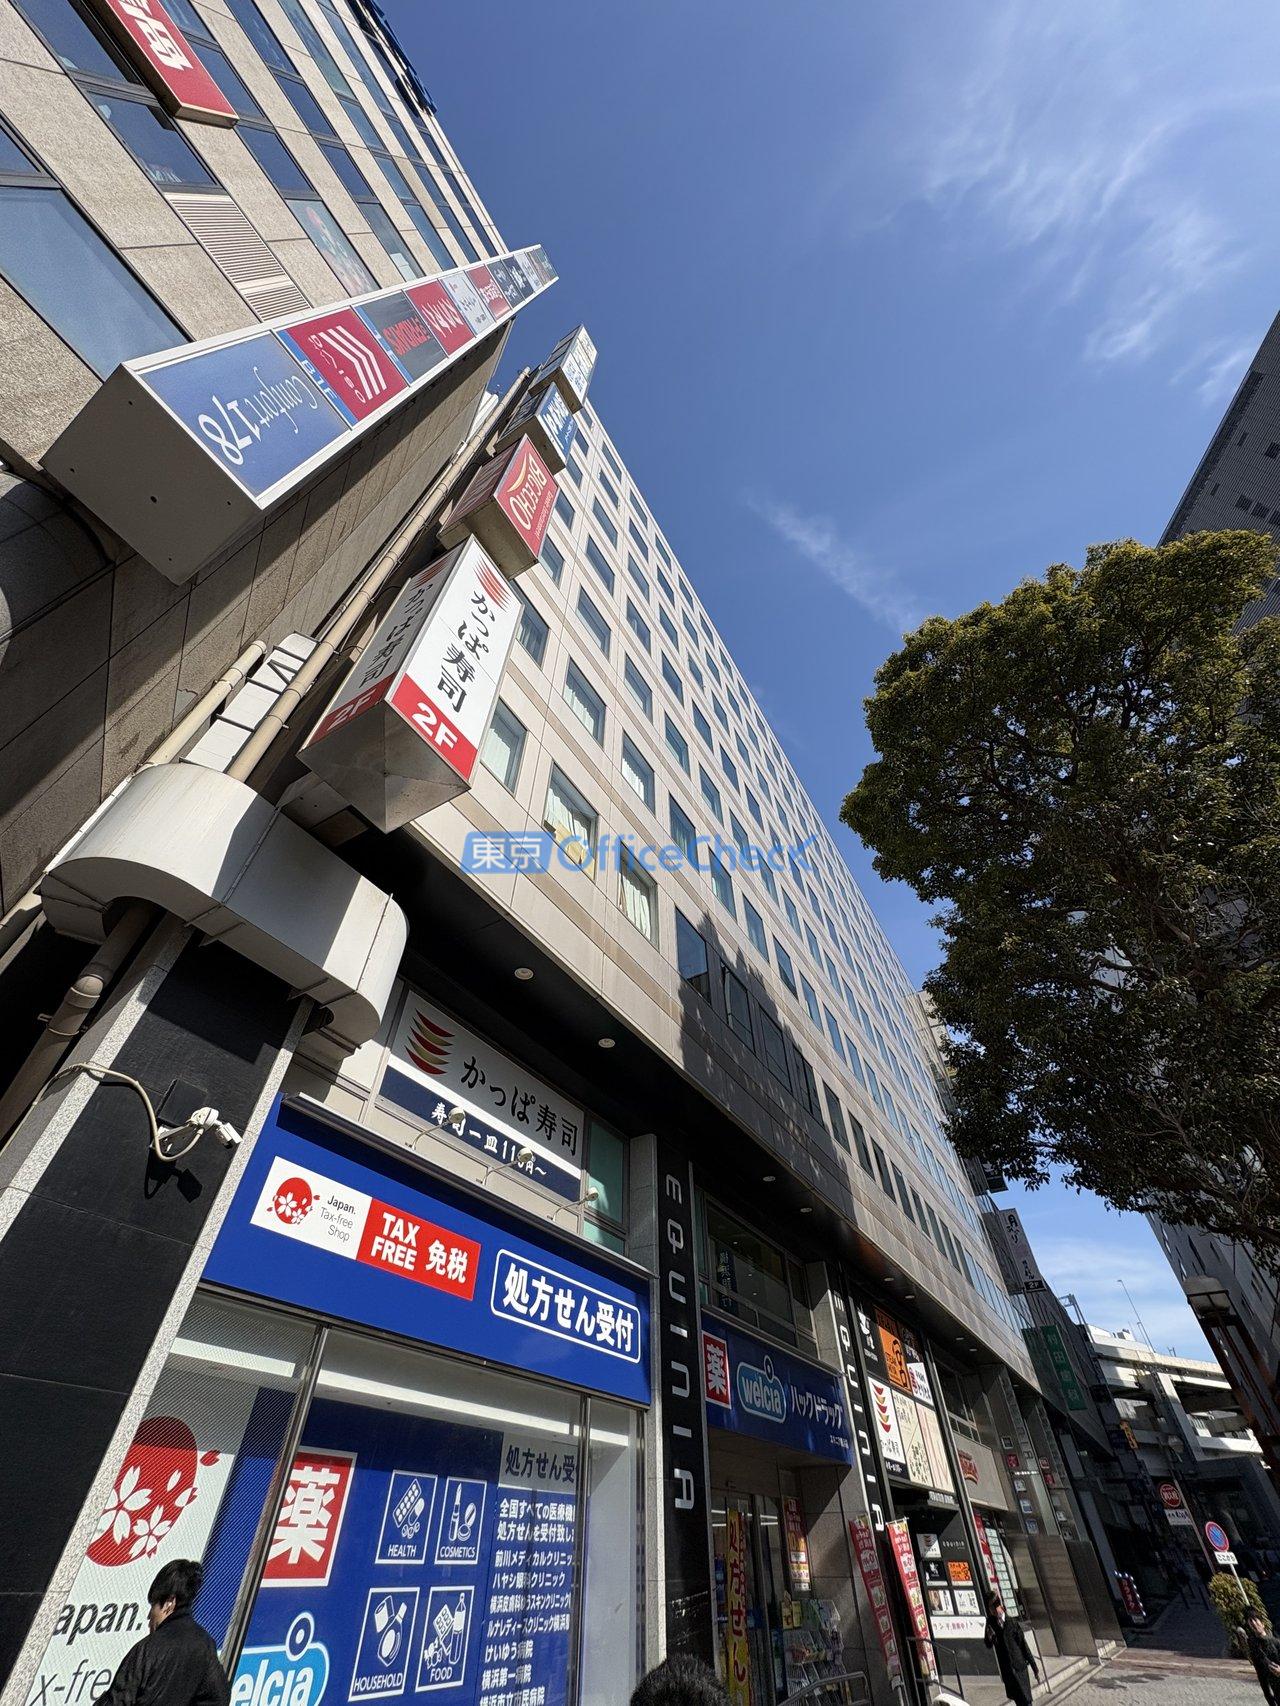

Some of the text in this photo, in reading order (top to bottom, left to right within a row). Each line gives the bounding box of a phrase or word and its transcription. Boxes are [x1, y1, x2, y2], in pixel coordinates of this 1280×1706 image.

[300, 358, 339, 402] B1F
[307, 333, 367, 404] DAISO
[197, 365, 319, 466] Comfort 178
[437, 589, 496, 714] かっぱ寿司
[326, 687, 378, 732] 2F
[412, 702, 460, 750] 2F
[460, 1056, 579, 1157] かっぱ寿司
[320, 1206, 354, 1230] Tax-free
[327, 1194, 356, 1216] Japan.
[327, 1223, 351, 1243] Shop
[382, 1212, 420, 1246] TAX
[371, 1242, 418, 1272] FREE
[425, 1239, 468, 1284] 免税
[503, 1262, 634, 1354] 処方せん受付
[666, 1174, 695, 1510] EQUINIA
[706, 1341, 727, 1397] 薬
[742, 1373, 783, 1415] welcia
[790, 1384, 844, 1430] ハックドラッグ
[833, 1291, 884, 1531] EQUINIA
[505, 1445, 577, 1482] 処方せん受
[267, 1466, 340, 1566] 薬
[500, 1498, 575, 1523] 全国すべての医療機
[388, 1544, 417, 1558] HEALTH
[440, 1545, 477, 1559] COSMETICS
[495, 1549, 575, 1568] 前川メディカルクリニッ
[353, 1672, 404, 1694] HOUSEHOLD
[429, 1666, 453, 1682] FOOD
